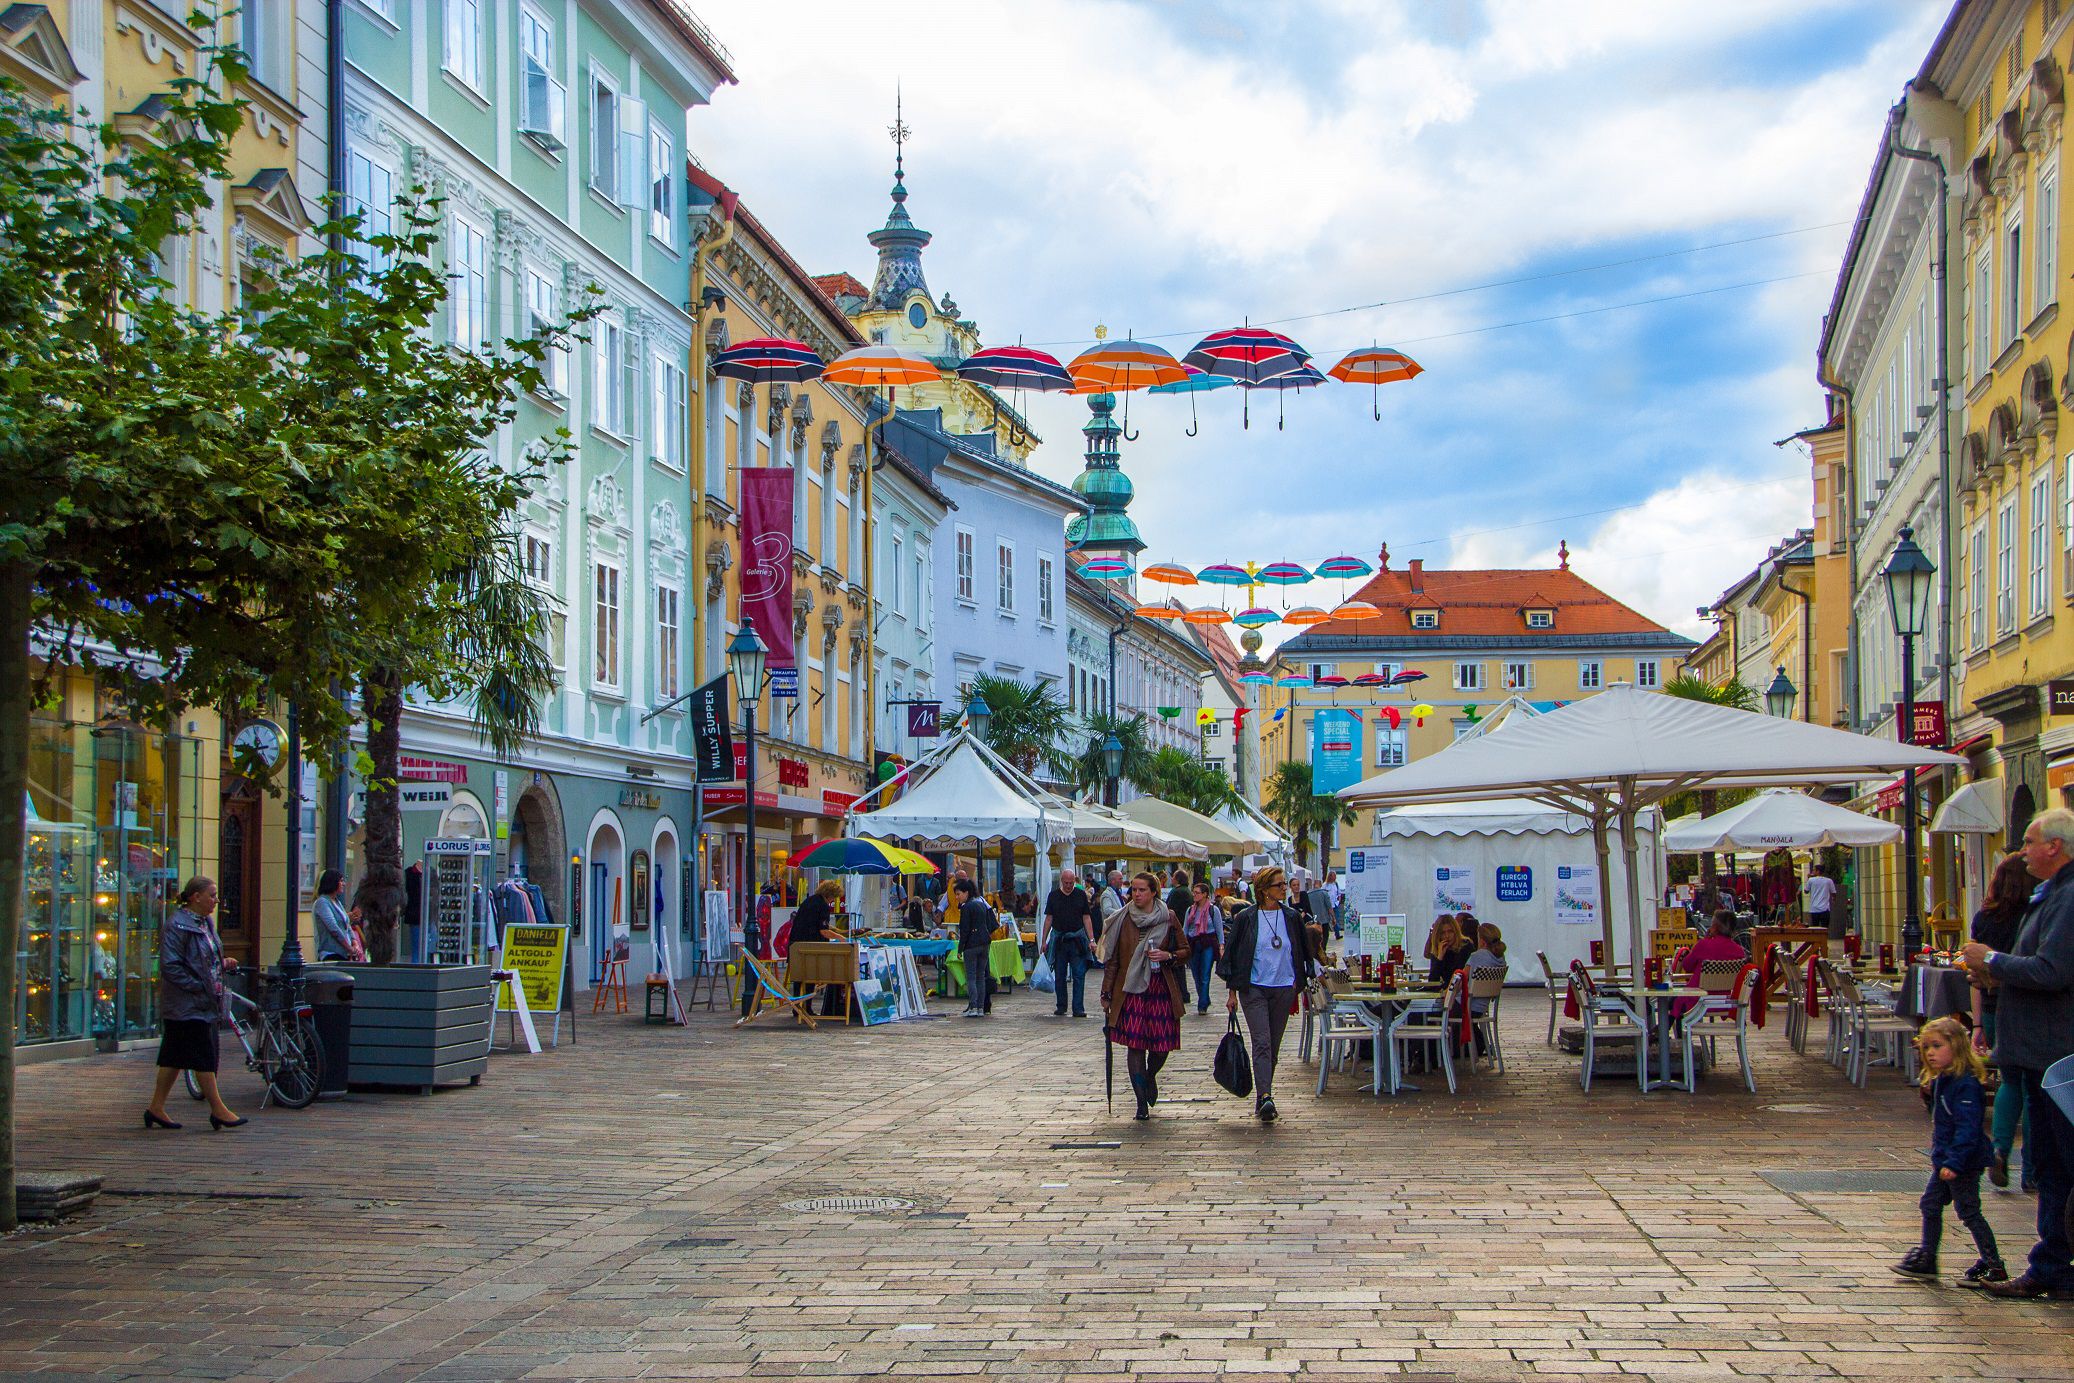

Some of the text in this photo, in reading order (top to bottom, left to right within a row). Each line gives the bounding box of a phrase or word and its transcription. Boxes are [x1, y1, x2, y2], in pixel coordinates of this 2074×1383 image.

[742, 531, 791, 602] 3
[746, 568, 767, 576] Galerie
[1913, 707, 1938, 715] MMERS
[912, 709, 934, 731] M
[705, 690, 720, 770] WILLY SUPPER
[1323, 727, 1350, 735] SPECIAL
[1914, 730, 1940, 741] EHAUS
[1760, 836, 1794, 845] MANDALA
[435, 842, 470, 851] LORUS
[477, 843, 491, 851] LORUS
[1500, 873, 1528, 881] EUREGIO
[516, 928, 556, 940] DANIELA
[1363, 926, 1380, 934] TAG
[1362, 934, 1386, 942] TEES
[1656, 943, 1668, 951] TO
[508, 949, 556, 958] ALTGOLD-
[510, 959, 551, 967] ANKAUF
